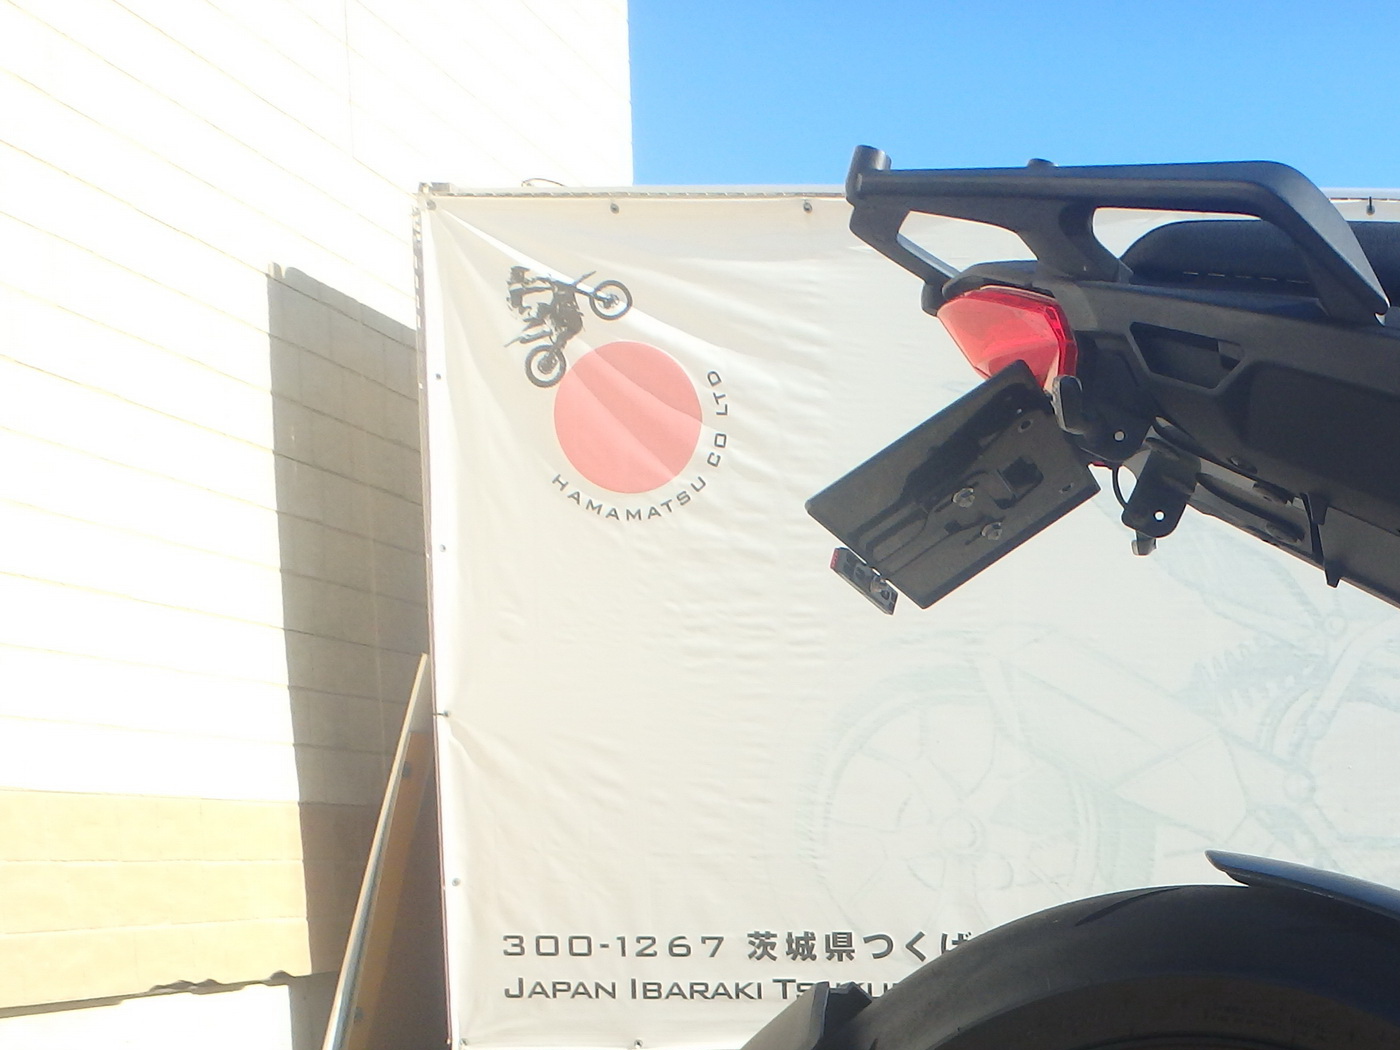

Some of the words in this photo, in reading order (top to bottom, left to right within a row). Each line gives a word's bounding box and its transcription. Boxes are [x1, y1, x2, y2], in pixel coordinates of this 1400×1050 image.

[707, 371, 728, 416] LTD
[707, 433, 727, 467] CO
[552, 474, 706, 521] HAMAMATSU
[503, 935, 725, 958] 300-1267
[504, 977, 617, 999] JAPAN
[630, 978, 763, 1000] IBARAKI
